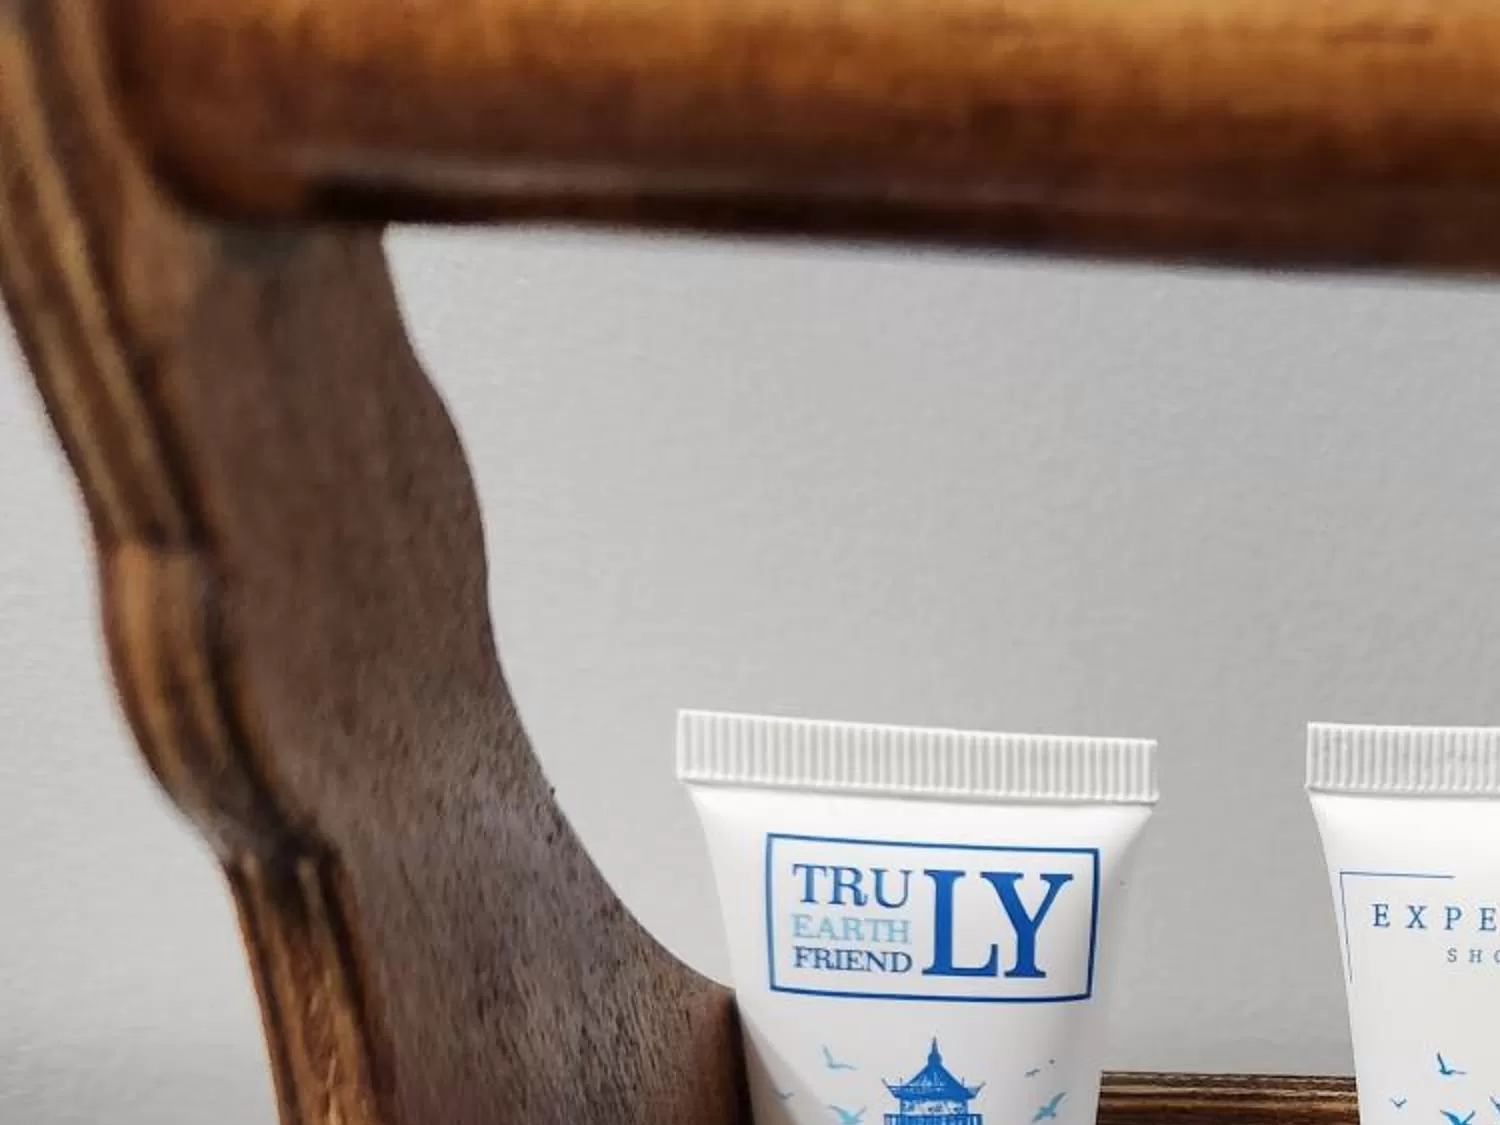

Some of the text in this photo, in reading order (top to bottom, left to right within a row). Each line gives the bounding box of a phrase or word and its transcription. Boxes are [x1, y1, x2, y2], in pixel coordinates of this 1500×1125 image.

[792, 862, 1074, 980] TRU LY
[792, 914, 911, 945] EARTH
[792, 946, 913, 974] FRIEND
